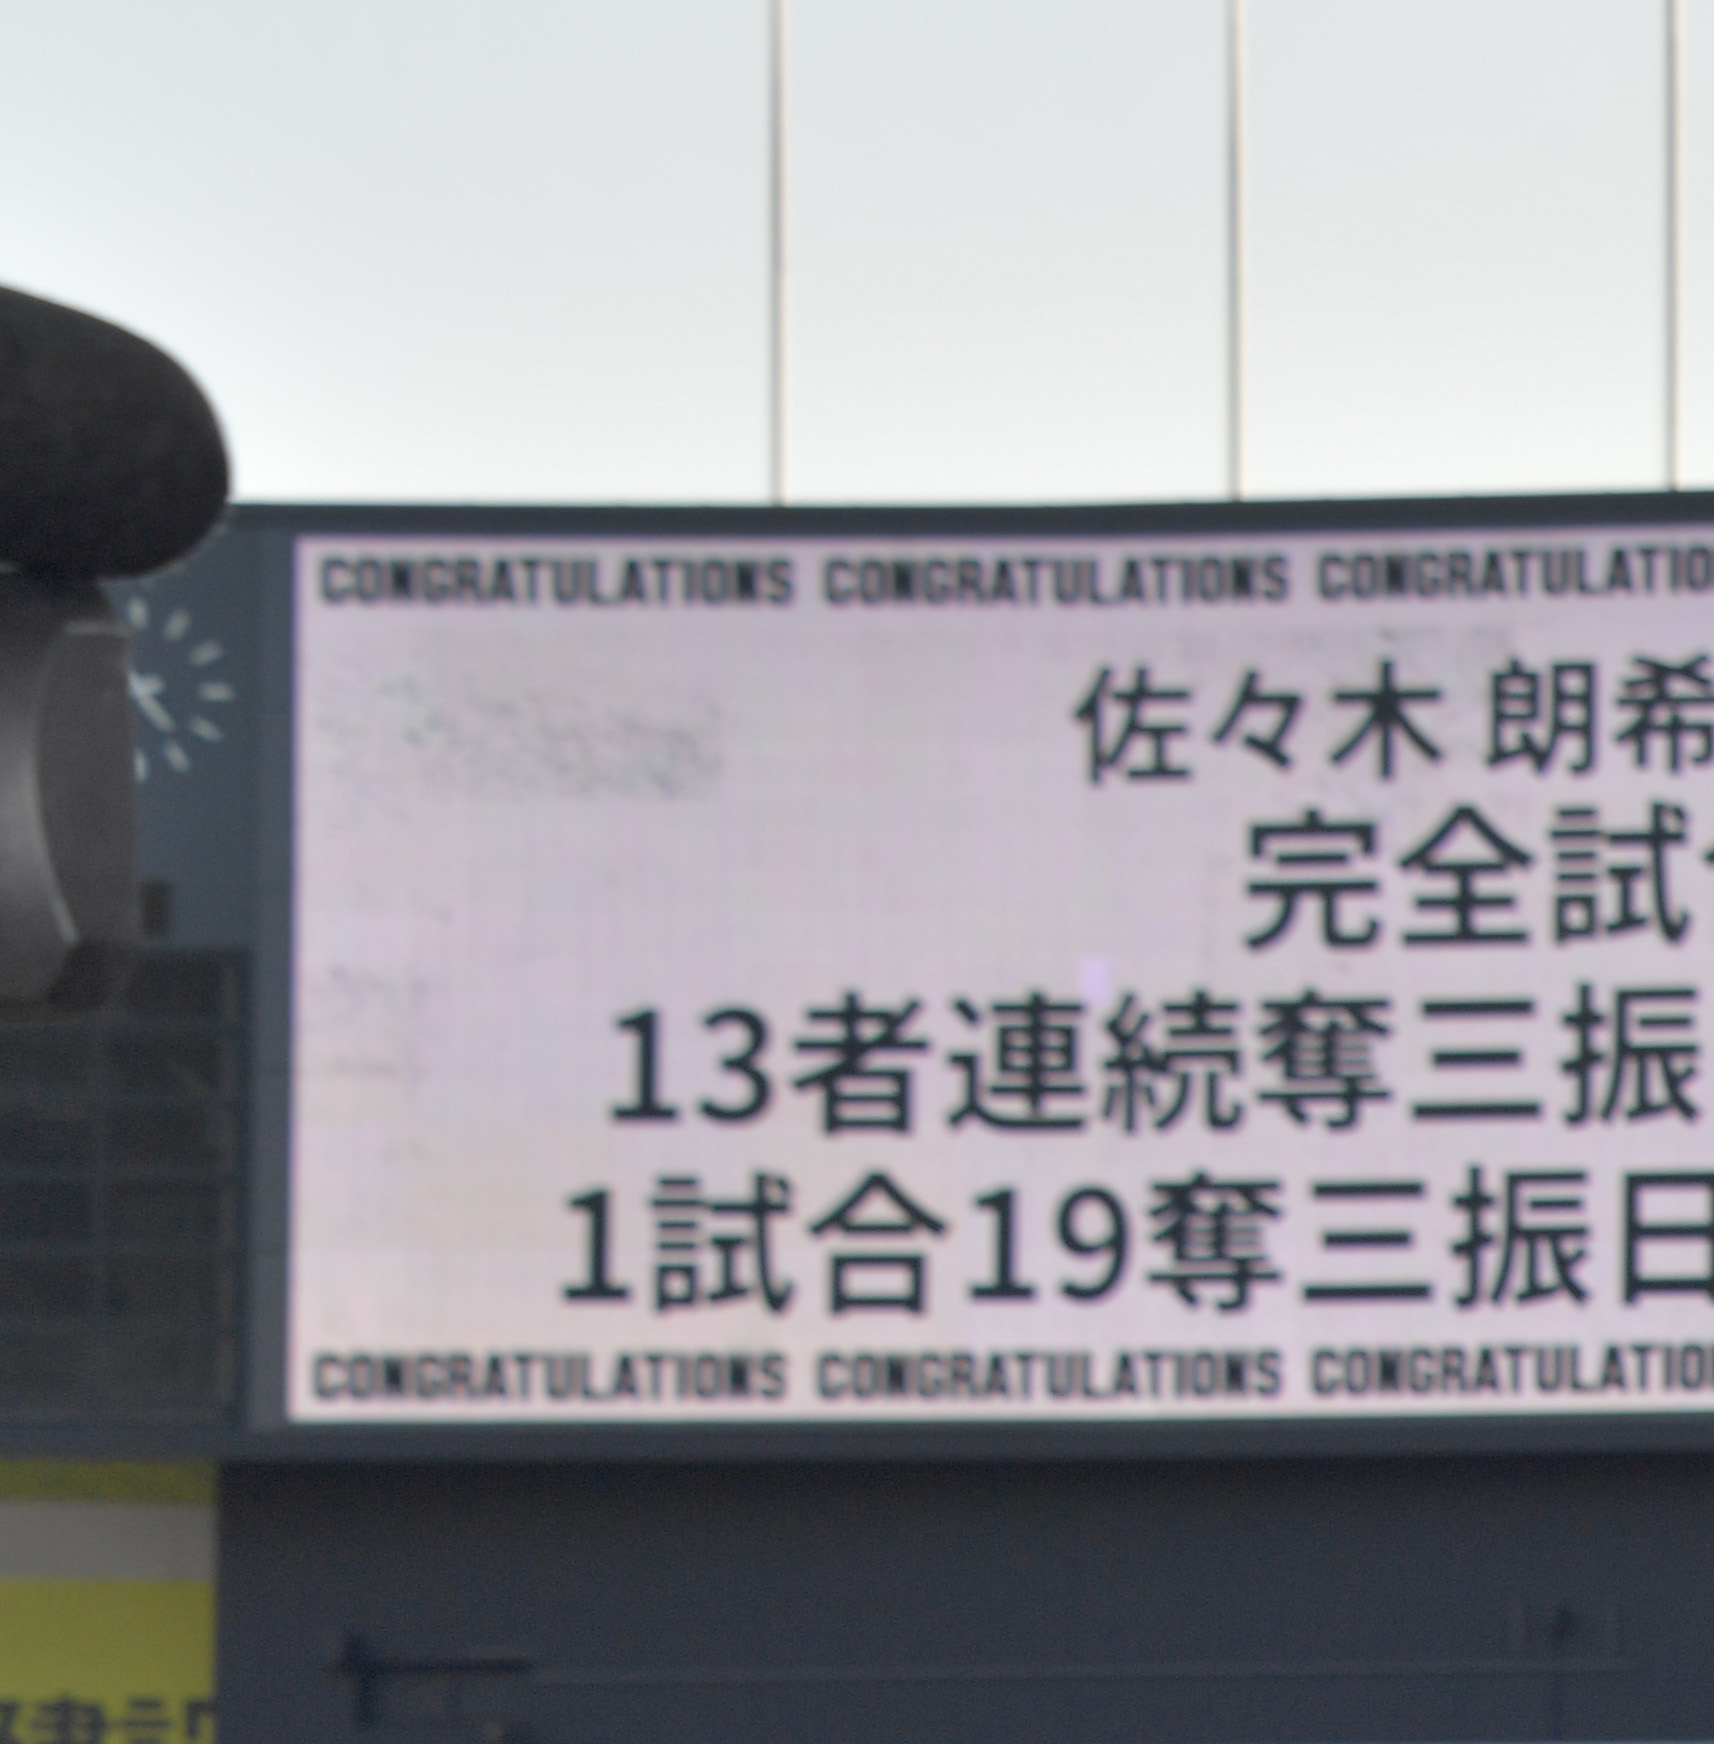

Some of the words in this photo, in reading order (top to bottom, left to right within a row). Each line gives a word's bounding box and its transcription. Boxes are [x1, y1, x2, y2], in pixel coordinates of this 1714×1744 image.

[319, 555, 795, 606] CONGRATULATIONS
[823, 553, 1290, 606] CONGRATULATIONS
[1073, 658, 1444, 784] 佐々木
[313, 1351, 787, 1402] CONGRATULATIONS
[816, 1348, 1283, 1401] CONGRATULATIONS
